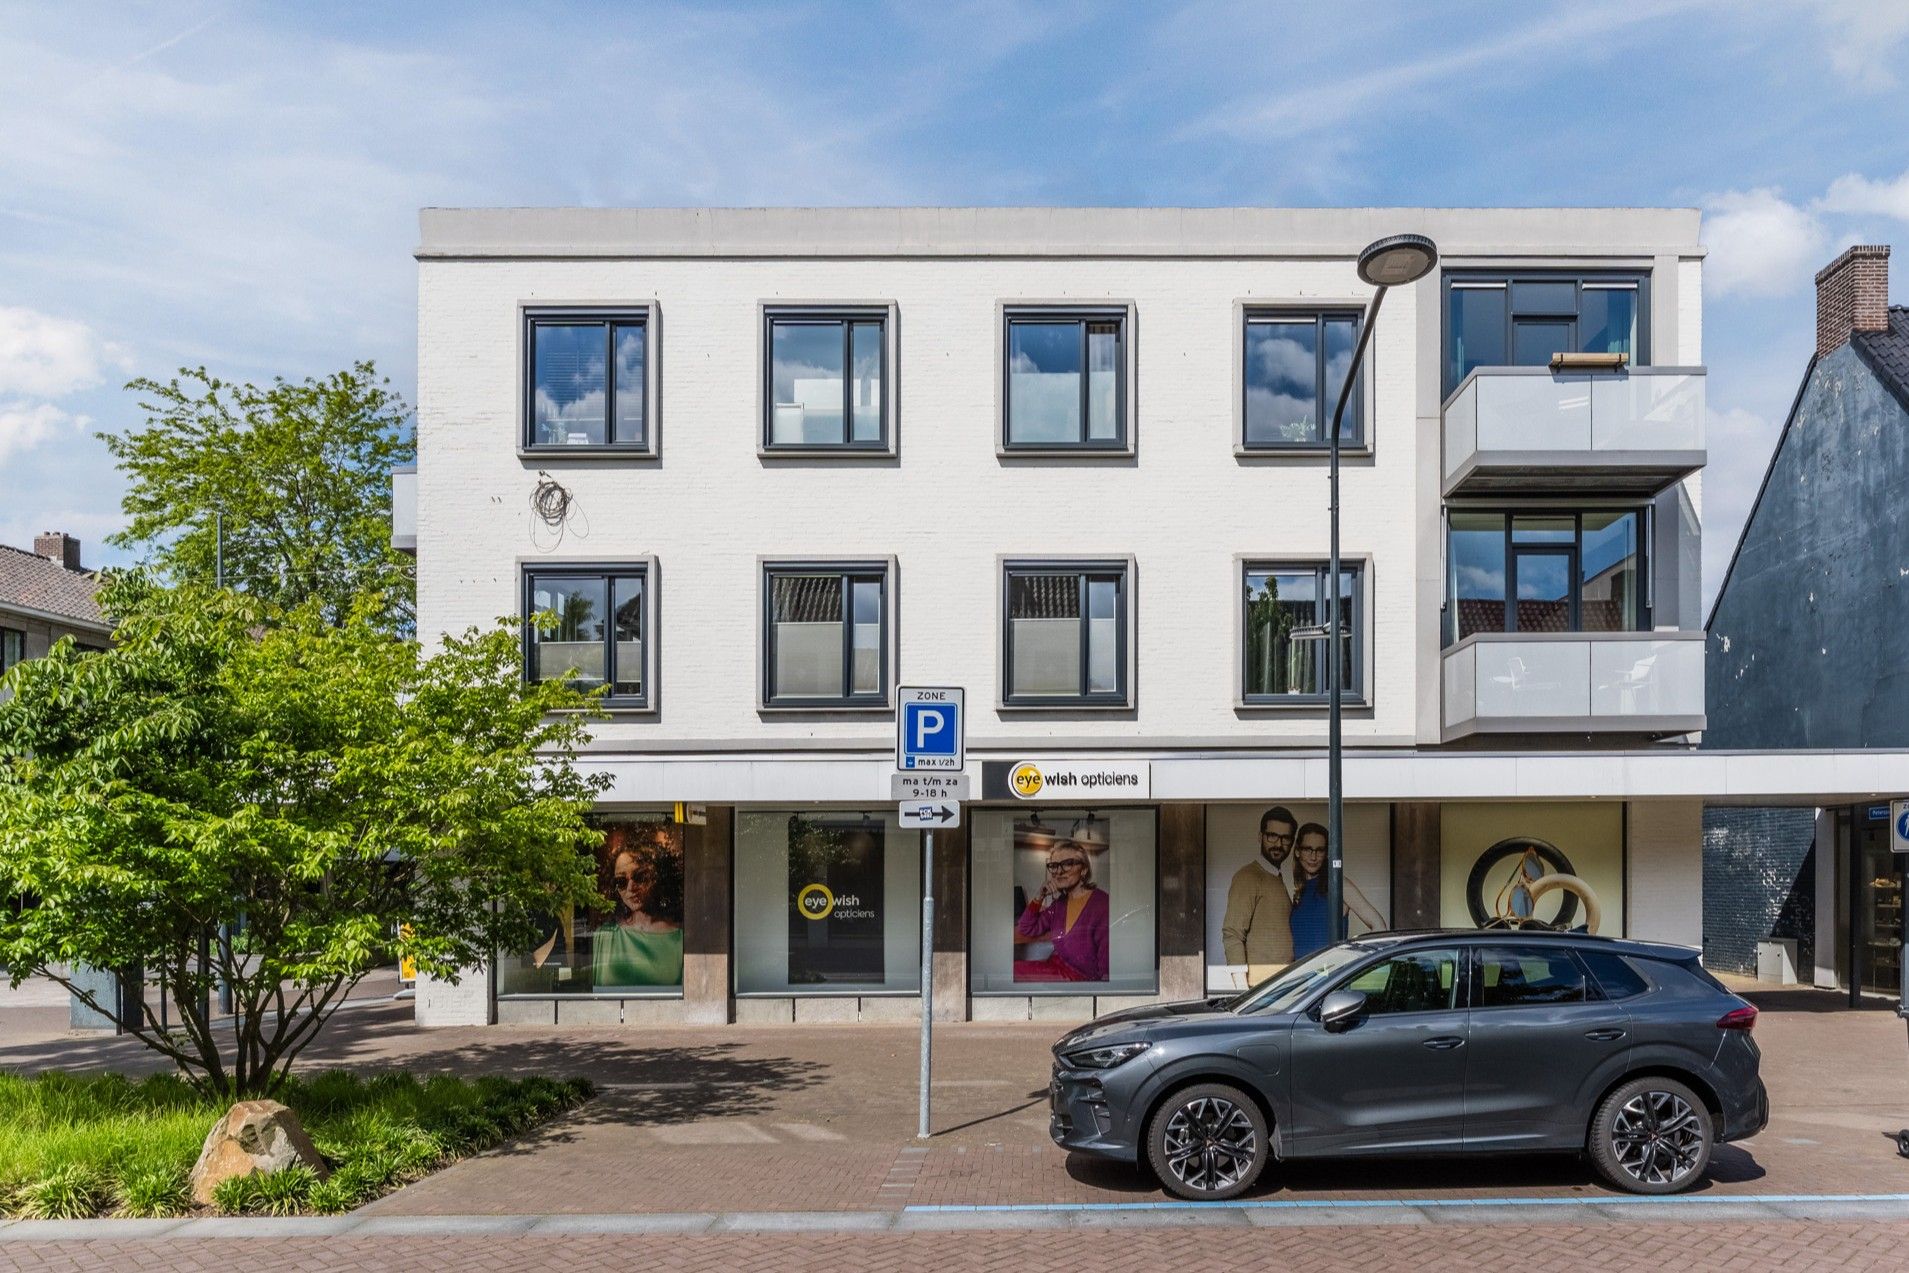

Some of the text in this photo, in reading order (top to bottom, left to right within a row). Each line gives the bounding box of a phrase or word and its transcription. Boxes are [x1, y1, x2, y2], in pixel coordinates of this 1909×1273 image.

[917, 691, 946, 700] ZONE
[917, 710, 945, 748] P
[918, 758, 937, 766] max
[903, 778, 919, 786] ma
[923, 776, 942, 786] t/m
[1016, 771, 1139, 789] eye wish opticiens
[912, 788, 947, 797] 9-18 h
[804, 894, 860, 909] eye wish
[833, 909, 875, 919] opticiens
